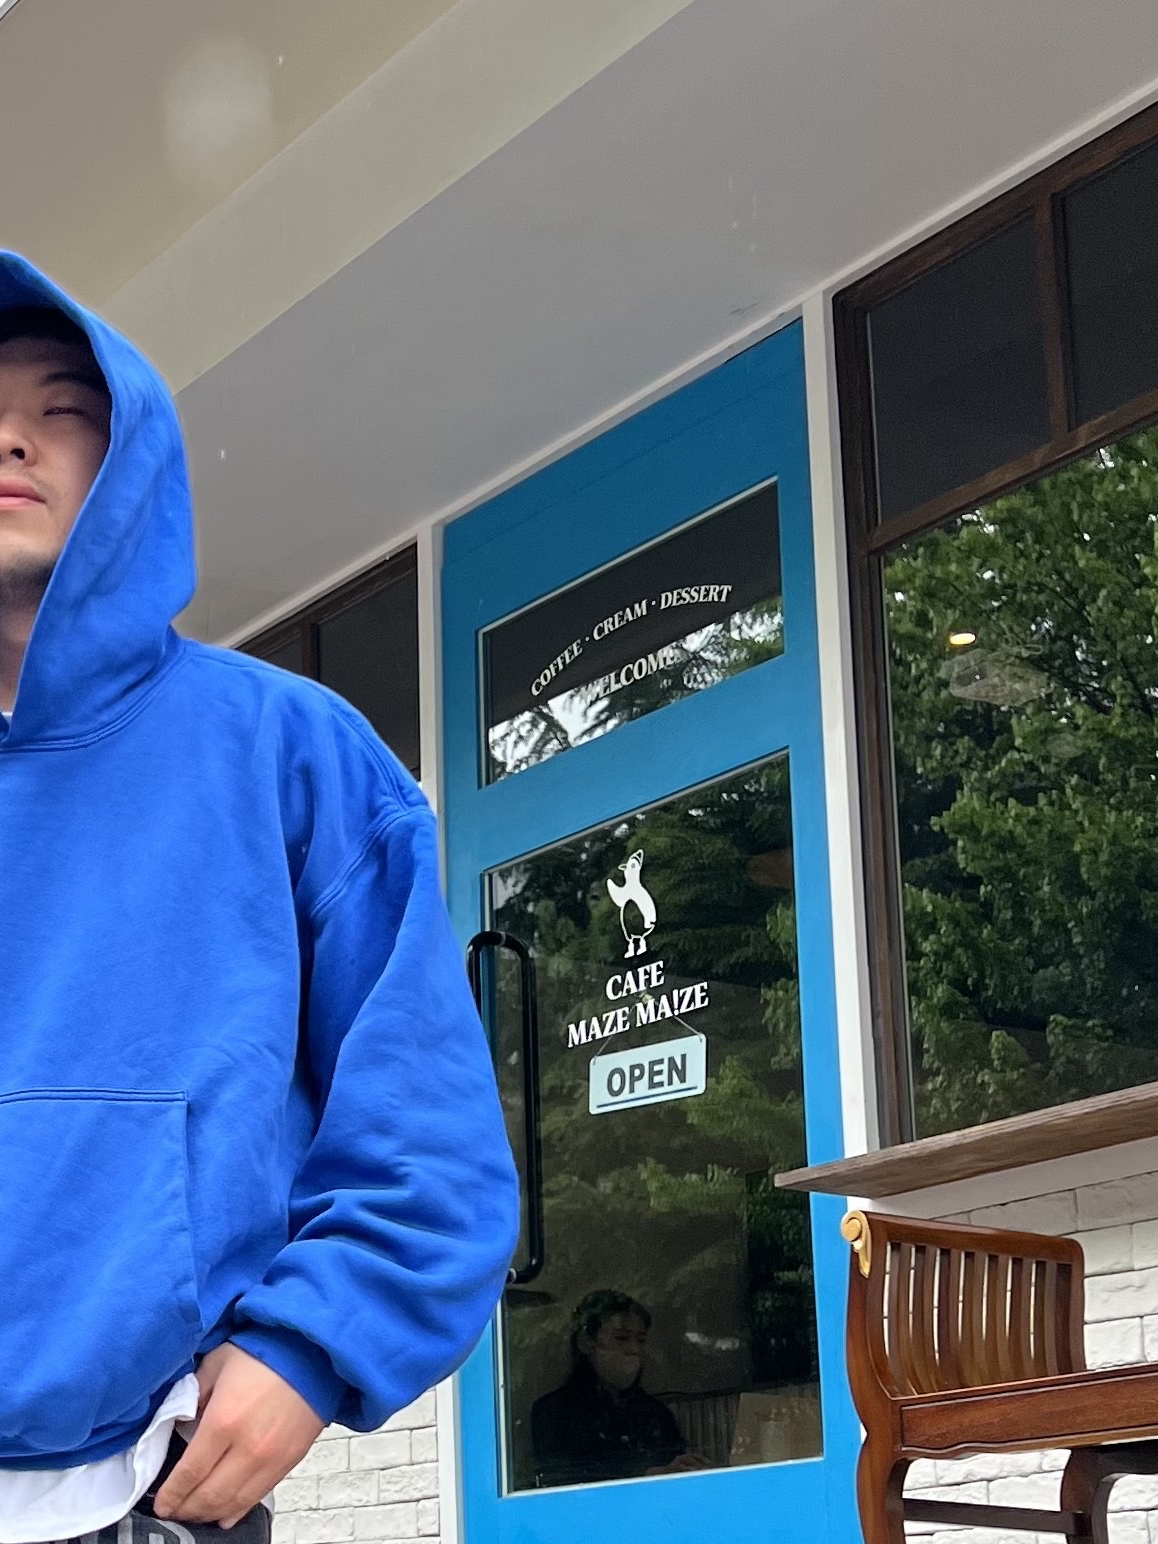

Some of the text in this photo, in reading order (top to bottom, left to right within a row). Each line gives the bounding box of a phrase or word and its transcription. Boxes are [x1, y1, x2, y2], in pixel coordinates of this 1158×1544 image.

[531, 584, 732, 696] COFFEE CREAM DESSERT
[605, 960, 665, 1001] CAFE
[567, 1006, 630, 1048] MAZE
[606, 1053, 687, 1098] OPEN
